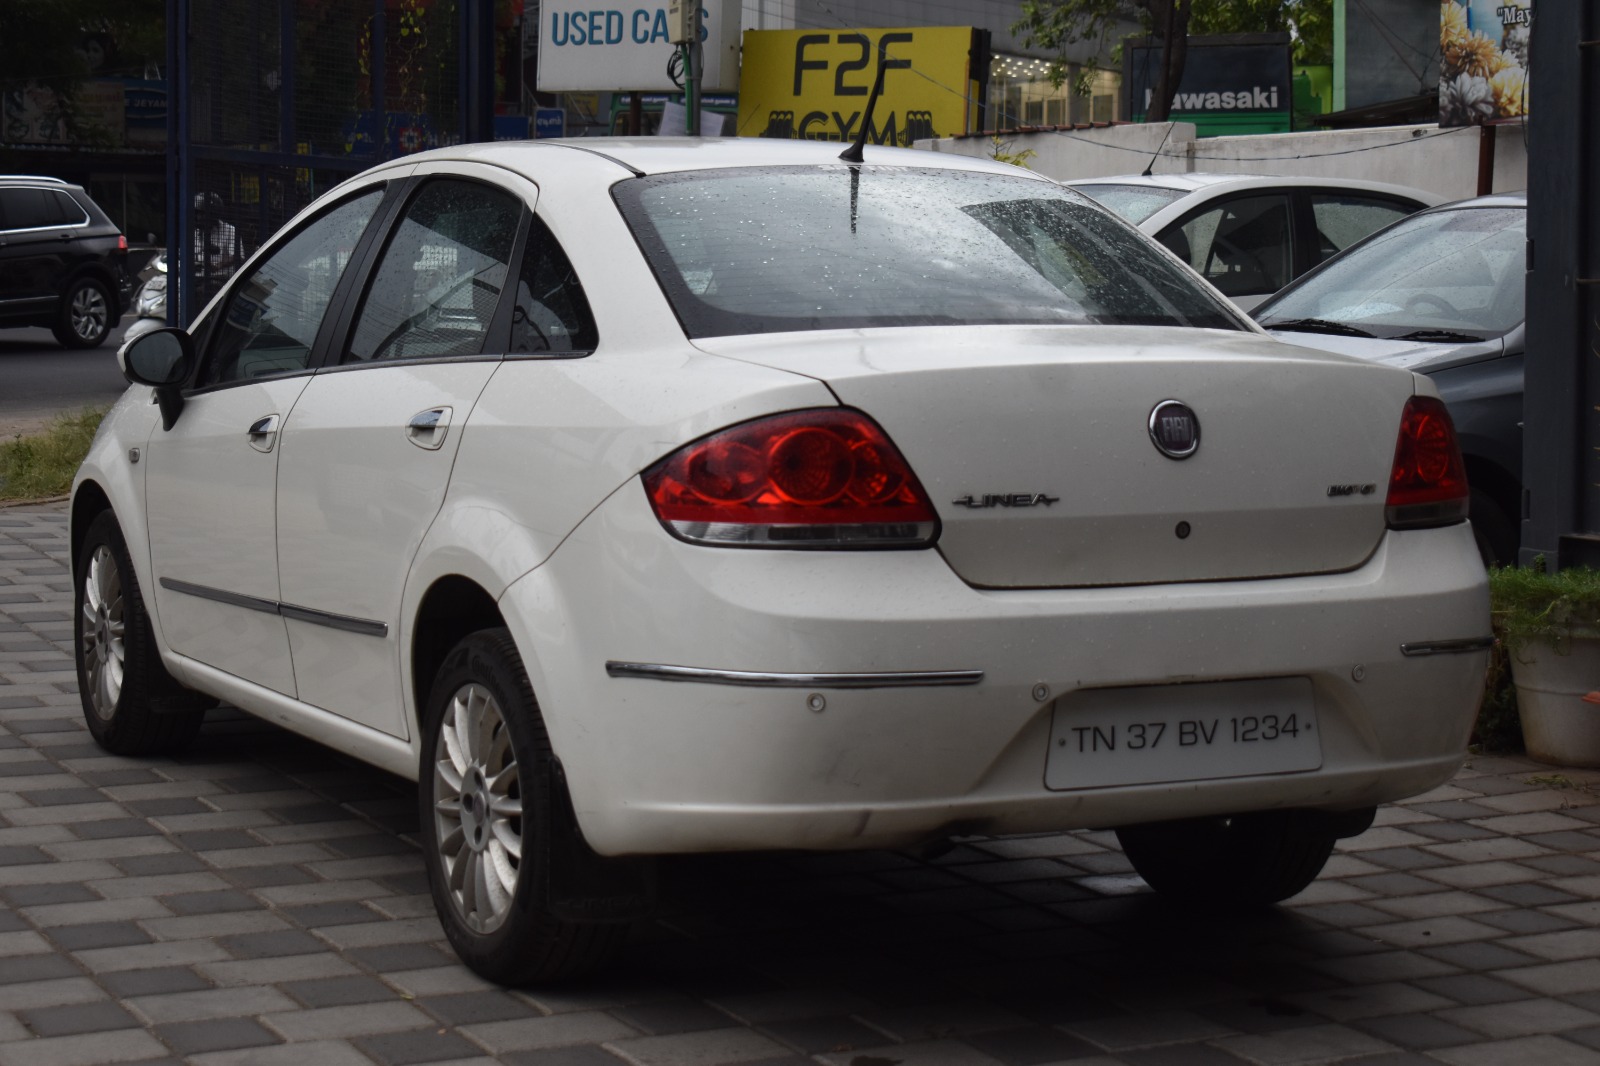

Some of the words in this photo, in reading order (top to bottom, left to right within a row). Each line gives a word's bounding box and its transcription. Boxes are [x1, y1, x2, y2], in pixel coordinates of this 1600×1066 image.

[552, 10, 624, 46] USED
[632, 9, 709, 44] CAS
[793, 33, 913, 97] F2F
[798, 110, 898, 147] GYM
[952, 492, 1060, 509] LINEA
[1071, 714, 1115, 753] TN
[1127, 722, 1167, 750] 37
[1179, 718, 1219, 747] BV
[1231, 712, 1300, 743] 1234
